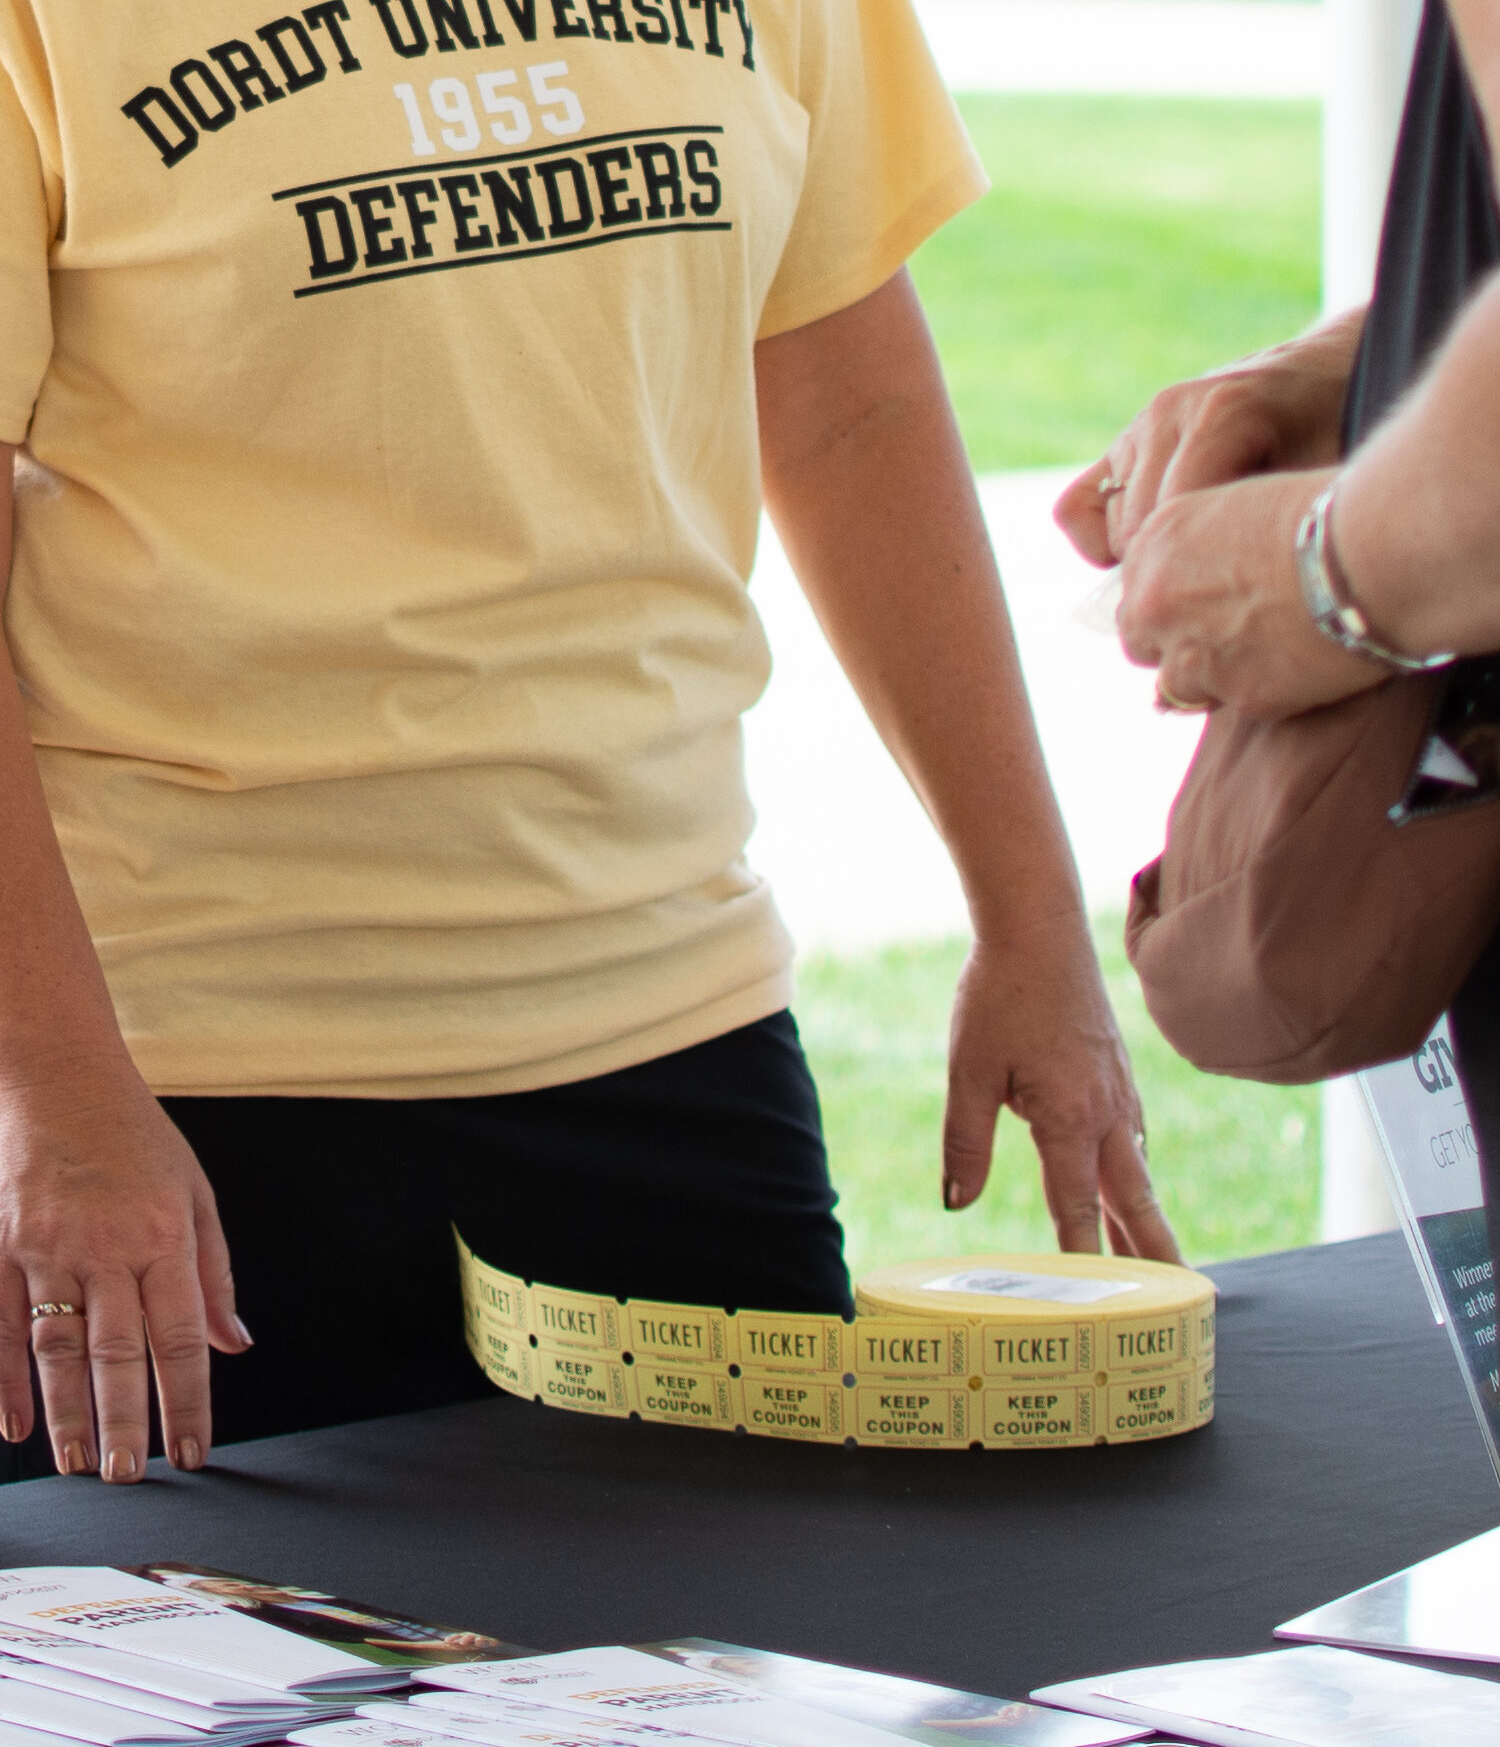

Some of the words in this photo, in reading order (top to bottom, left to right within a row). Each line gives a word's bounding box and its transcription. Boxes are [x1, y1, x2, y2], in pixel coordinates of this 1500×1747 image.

[394, 61, 586, 156] 1955
[295, 139, 722, 280] DEFENDERS
[1430, 1130, 1461, 1168] GET
[1465, 1298, 1479, 1318] at
[541, 1304, 597, 1336] TICKET
[639, 1319, 702, 1349] TICKET
[1117, 1328, 1175, 1358] TICKET
[748, 1331, 817, 1358] TICKET
[866, 1338, 941, 1363] TICKET
[995, 1339, 1070, 1364] TICKET
[556, 1359, 592, 1376] KEEP
[548, 1381, 606, 1402] COUPON
[656, 1374, 698, 1391] KEEP
[764, 1387, 808, 1403] KEEP
[880, 1395, 930, 1409] KEEP
[1008, 1395, 1058, 1409] KEEP
[1128, 1386, 1166, 1402] KEEP
[647, 1397, 712, 1416] COUPON
[753, 1410, 821, 1429] COUPON
[866, 1420, 944, 1435] COUPON
[993, 1420, 1071, 1436] COUPON
[1116, 1409, 1175, 1429] COUPON
[28, 1595, 184, 1618] DEFENDER
[54, 1602, 204, 1625] PARENT
[87, 1610, 229, 1630] HANDBOOK
[567, 1681, 719, 1700] DEFENDER
[597, 1688, 745, 1707] PARENT
